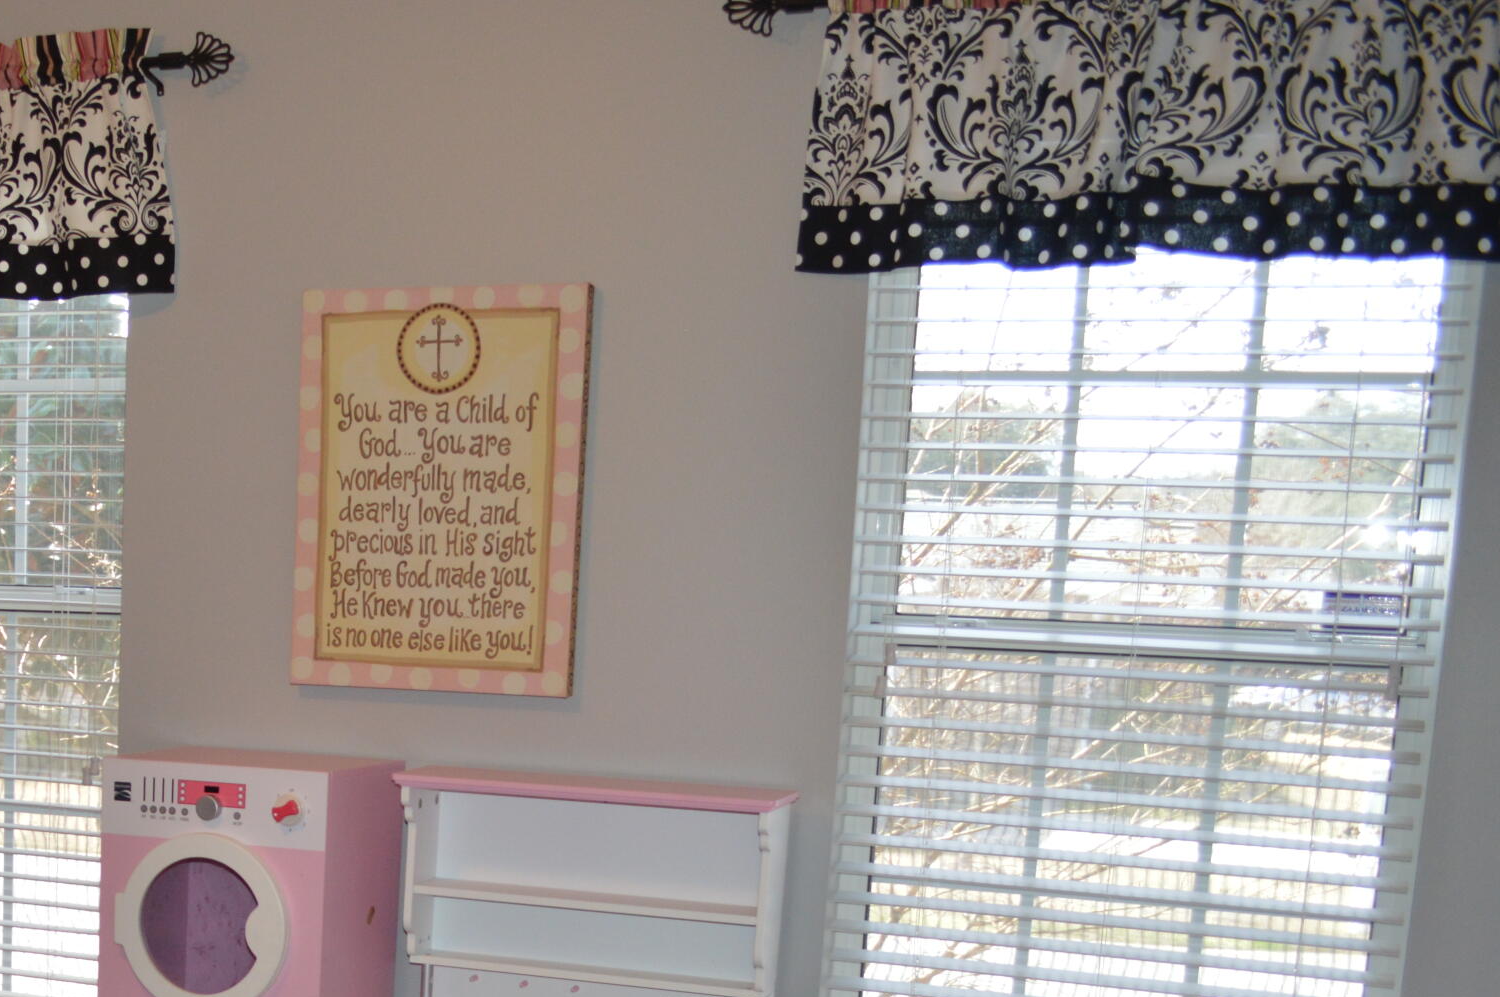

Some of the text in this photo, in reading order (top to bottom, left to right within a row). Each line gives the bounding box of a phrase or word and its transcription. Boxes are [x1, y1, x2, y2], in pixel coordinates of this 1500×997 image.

[334, 392, 539, 432] You are a Child of
[469, 433, 512, 458] are
[336, 462, 531, 504] wonderfully made,
[338, 496, 521, 532] dearly loved, and
[328, 526, 537, 562] precious in His sight
[330, 558, 535, 599] Before God made you,
[330, 588, 358, 620] He
[326, 623, 342, 648] is
[346, 627, 367, 648] no
[371, 627, 403, 649] one
[408, 629, 445, 652] else
[485, 625, 534, 659] you!
